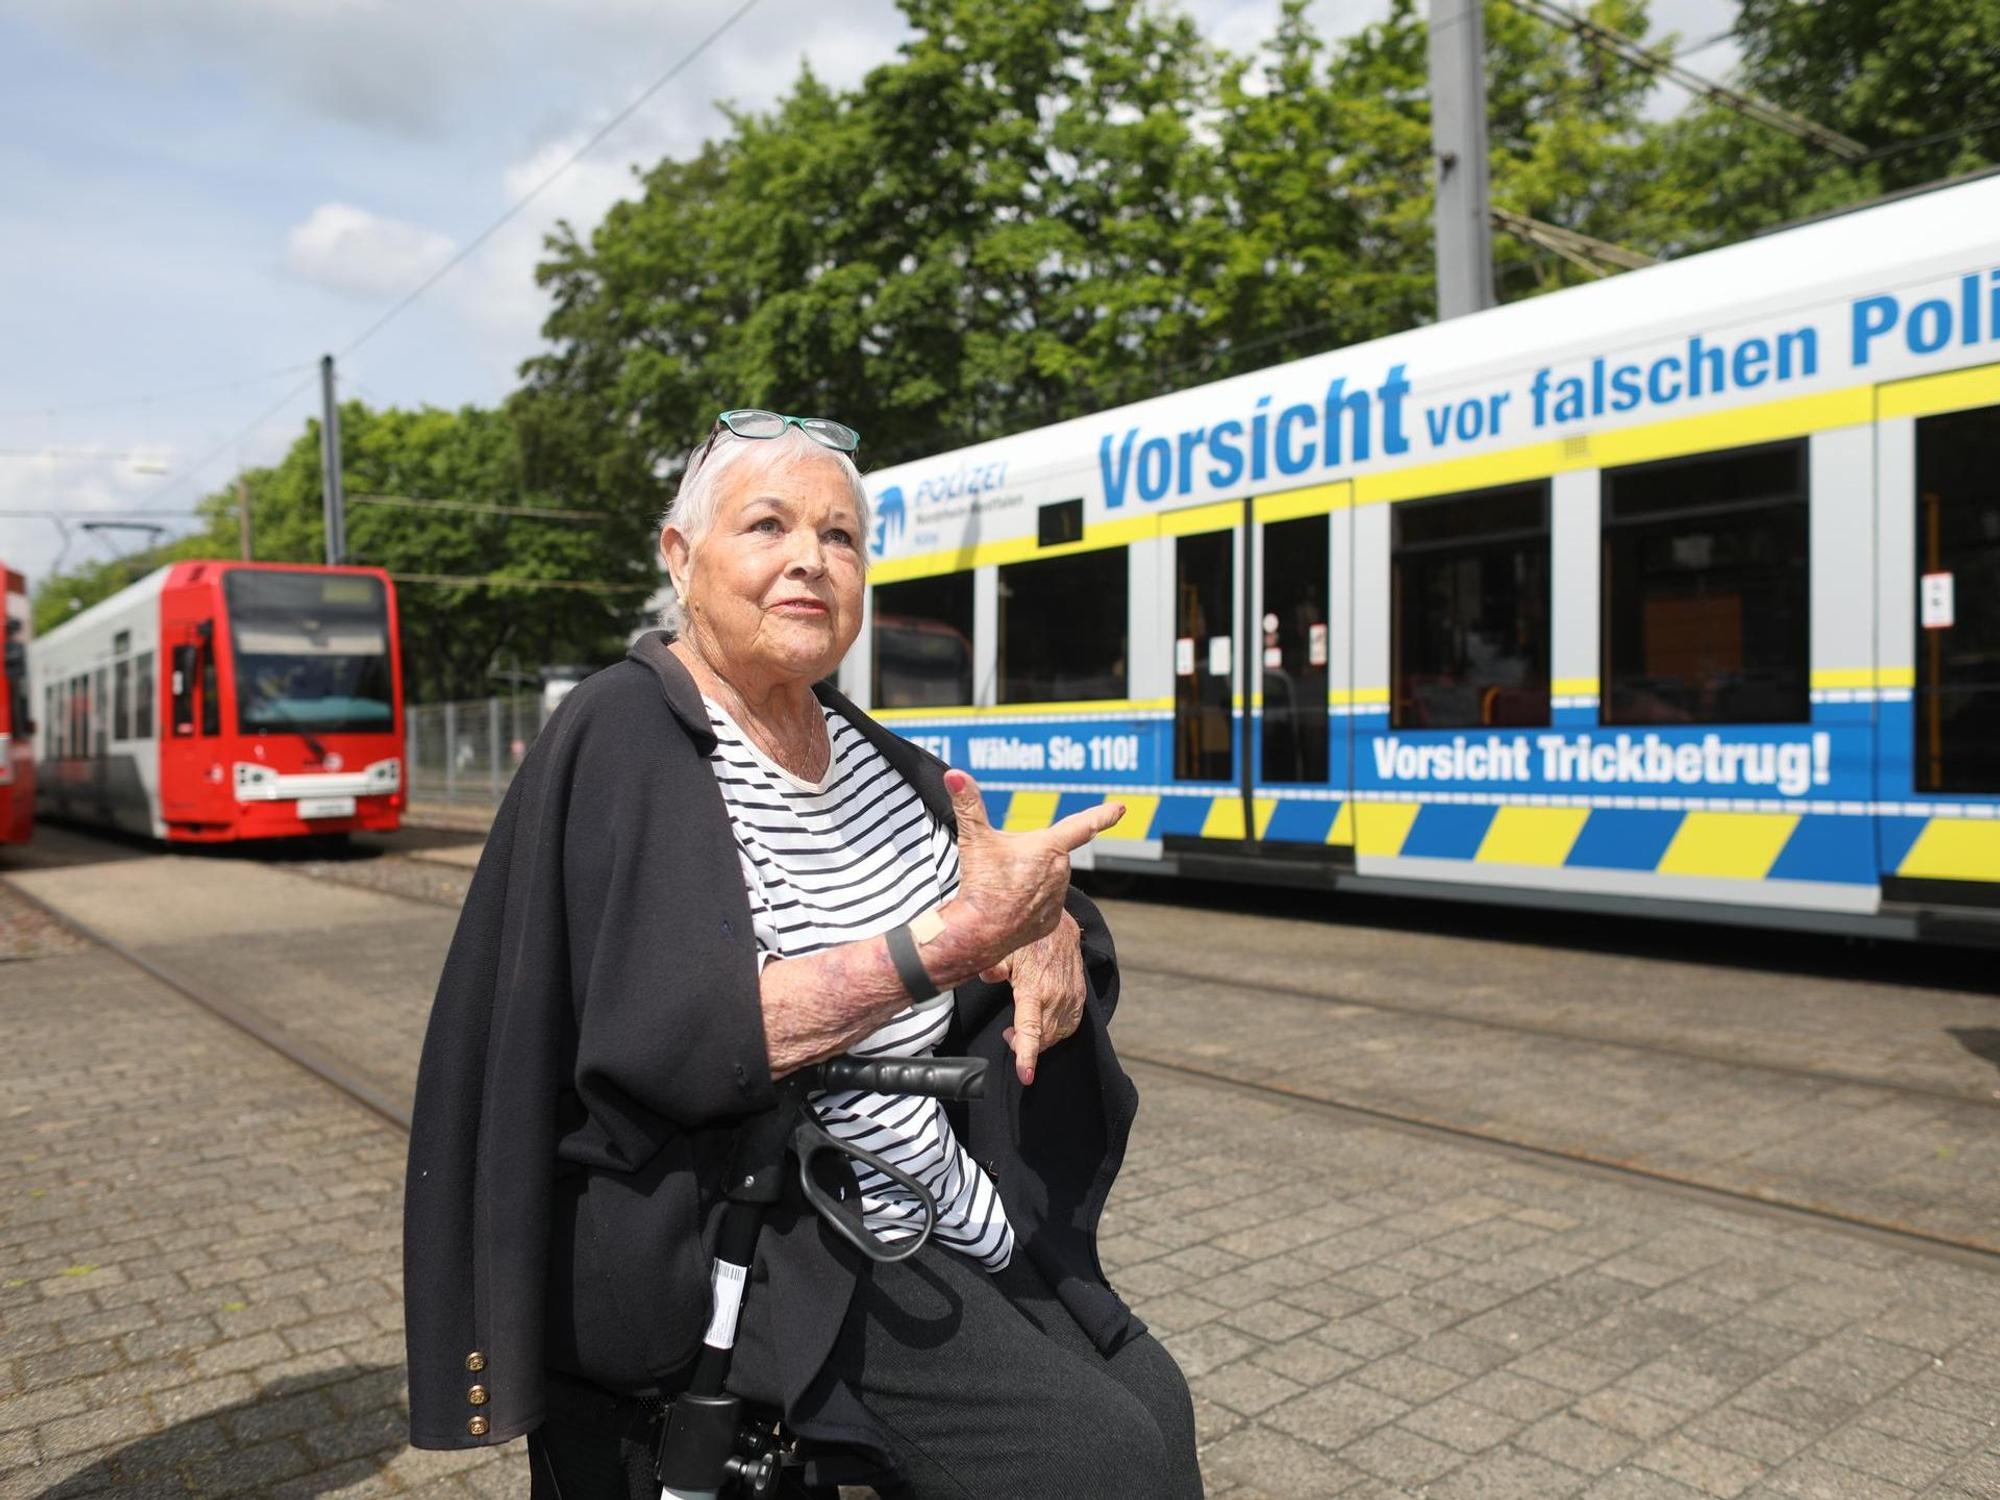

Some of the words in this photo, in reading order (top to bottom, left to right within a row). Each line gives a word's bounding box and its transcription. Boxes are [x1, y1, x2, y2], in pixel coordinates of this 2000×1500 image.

[1100, 365, 1411, 508] Vorsicht
[1427, 394, 1510, 447] vor
[1531, 327, 1817, 427] falschen
[915, 462, 1008, 505] POLIZEI
[968, 738, 1045, 771] Wählen
[1049, 736, 1085, 770] Sie
[1089, 736, 1138, 770] 110!
[1374, 737, 1530, 780] Vorsicht
[1536, 733, 1829, 796] Trickbetrug!
